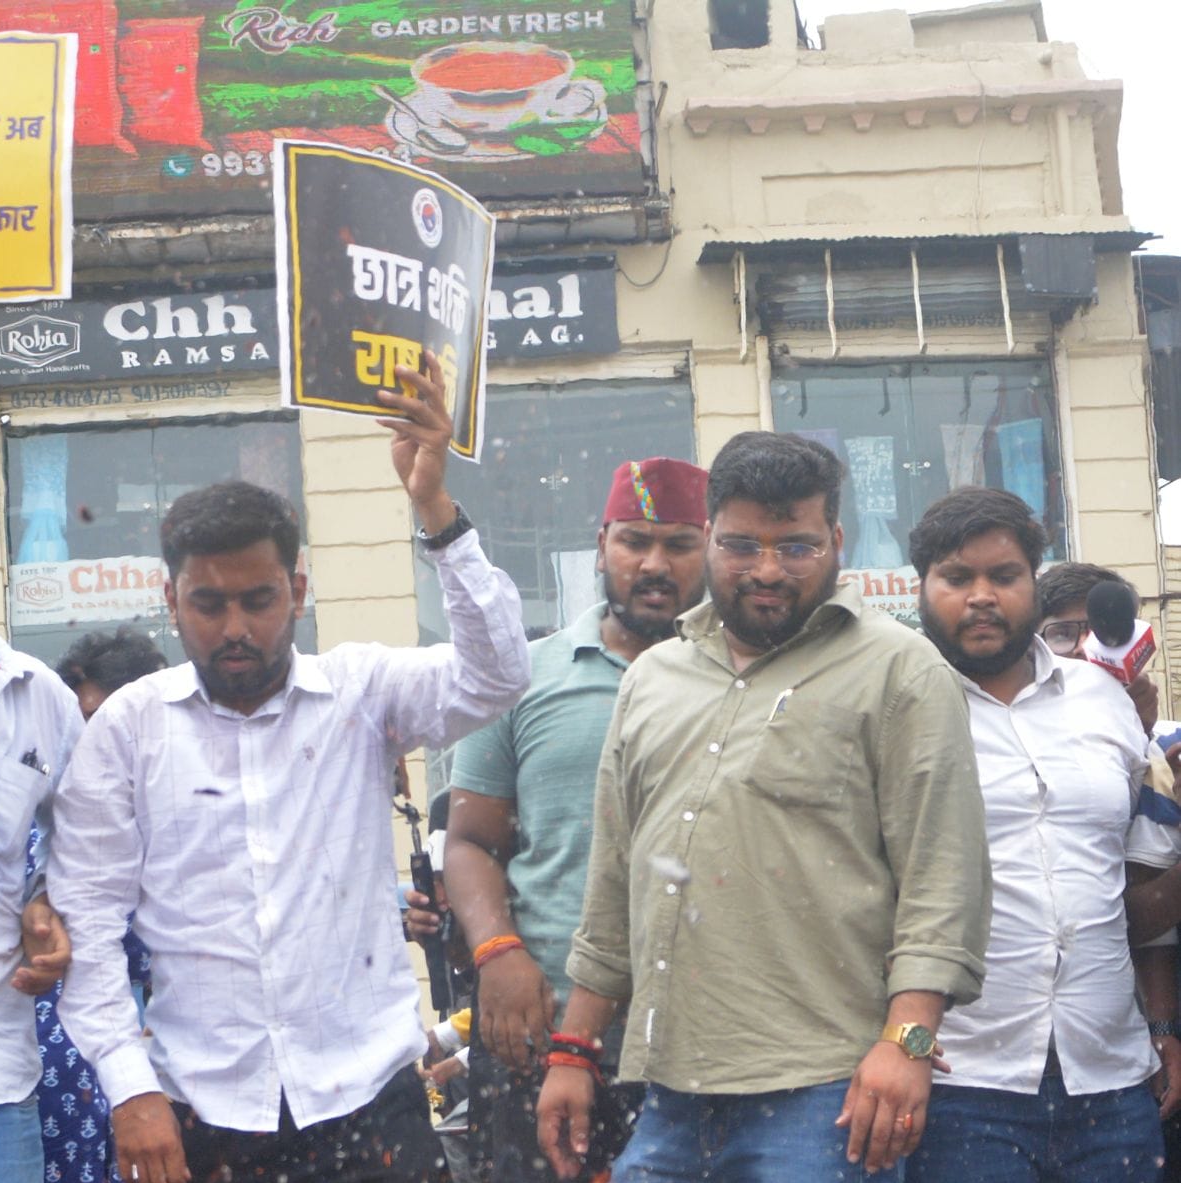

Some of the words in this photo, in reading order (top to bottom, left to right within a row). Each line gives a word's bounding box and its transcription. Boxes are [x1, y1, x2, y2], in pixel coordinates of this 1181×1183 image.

[223, 6, 341, 54] Rich
[370, 14, 502, 38] GARDEN
[508, 10, 605, 35] FRESH
[5, 116, 45, 141] अब
[347, 244, 423, 312] छात्र
